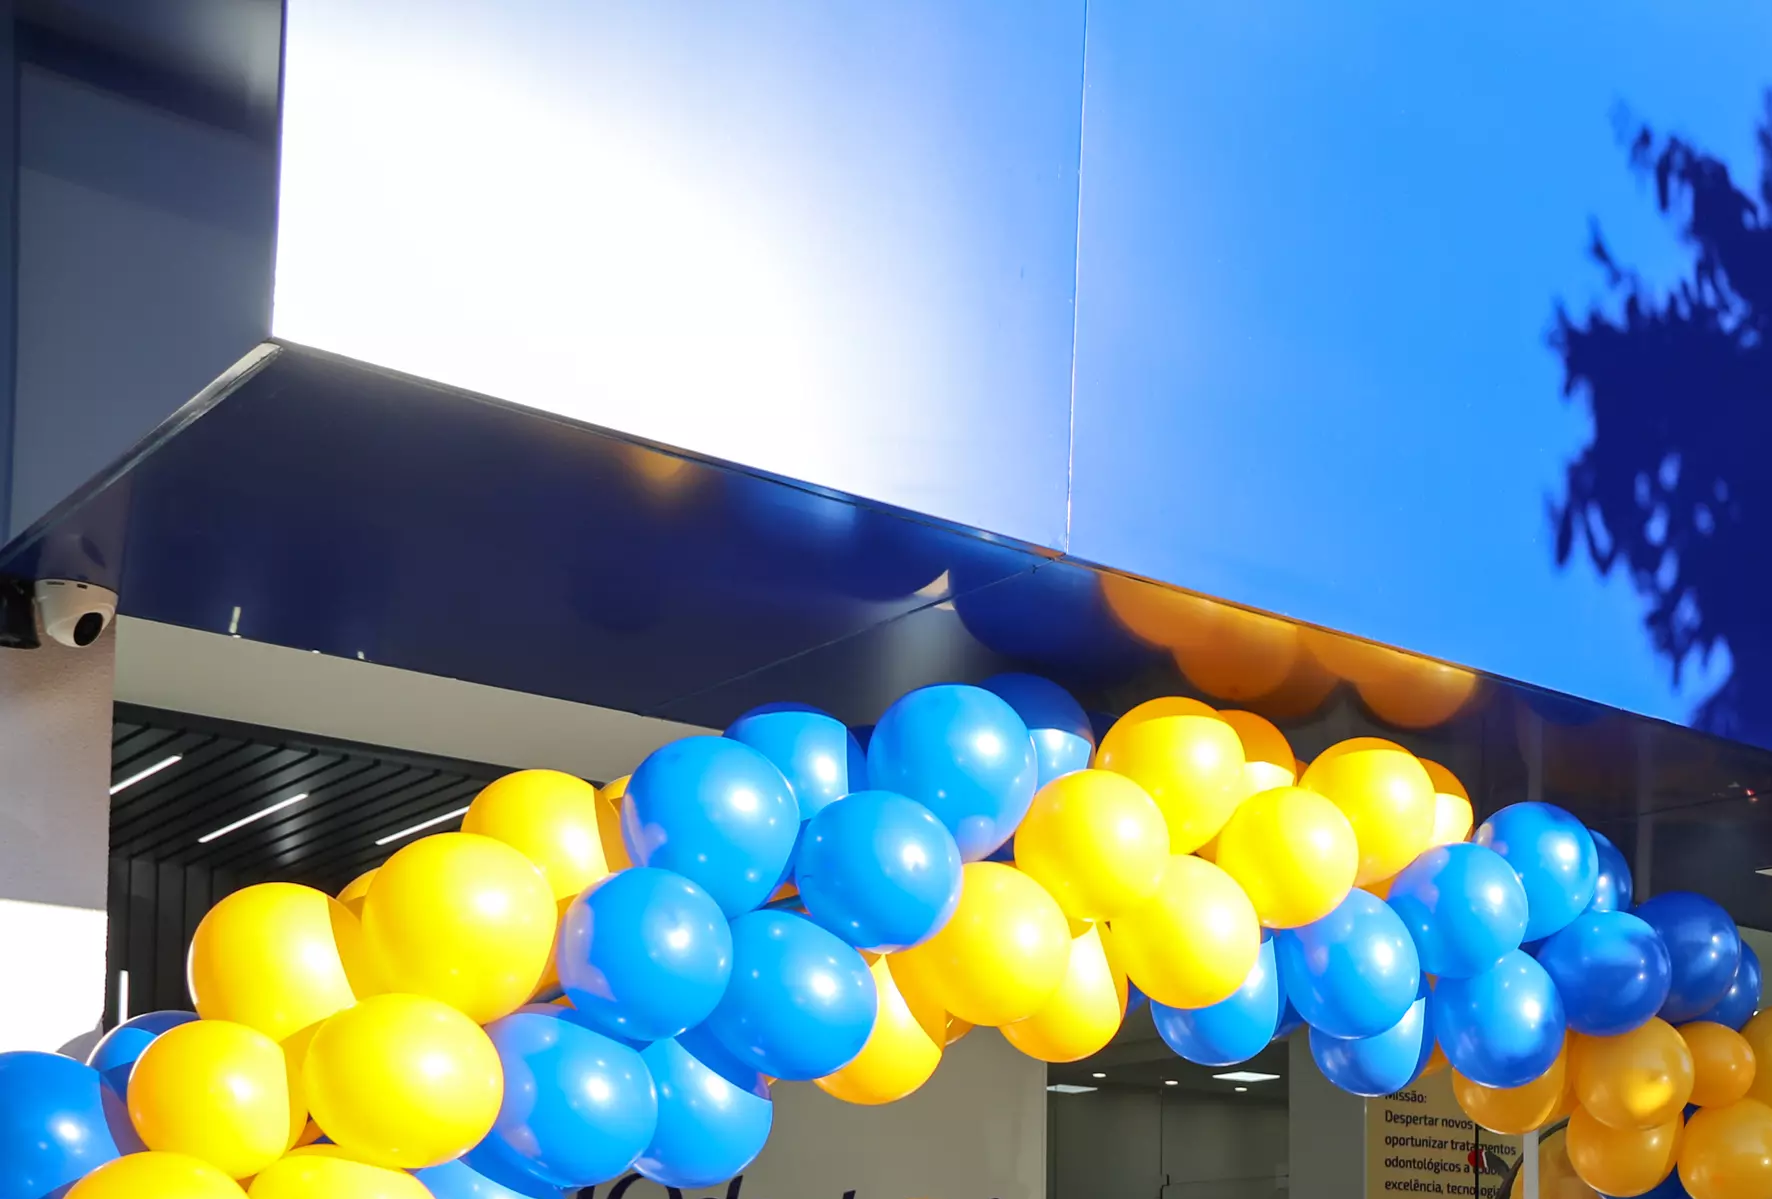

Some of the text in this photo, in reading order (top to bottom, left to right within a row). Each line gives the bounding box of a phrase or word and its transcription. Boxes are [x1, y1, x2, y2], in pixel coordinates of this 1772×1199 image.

[1385, 1110, 1473, 1130] Despertar novos
[1385, 1135, 1448, 1150] oportunizar
[1385, 1156, 1461, 1174] odontológicos
[1464, 1164, 1471, 1174] a
[1385, 1178, 1500, 1199] excelência, tecnoogi
